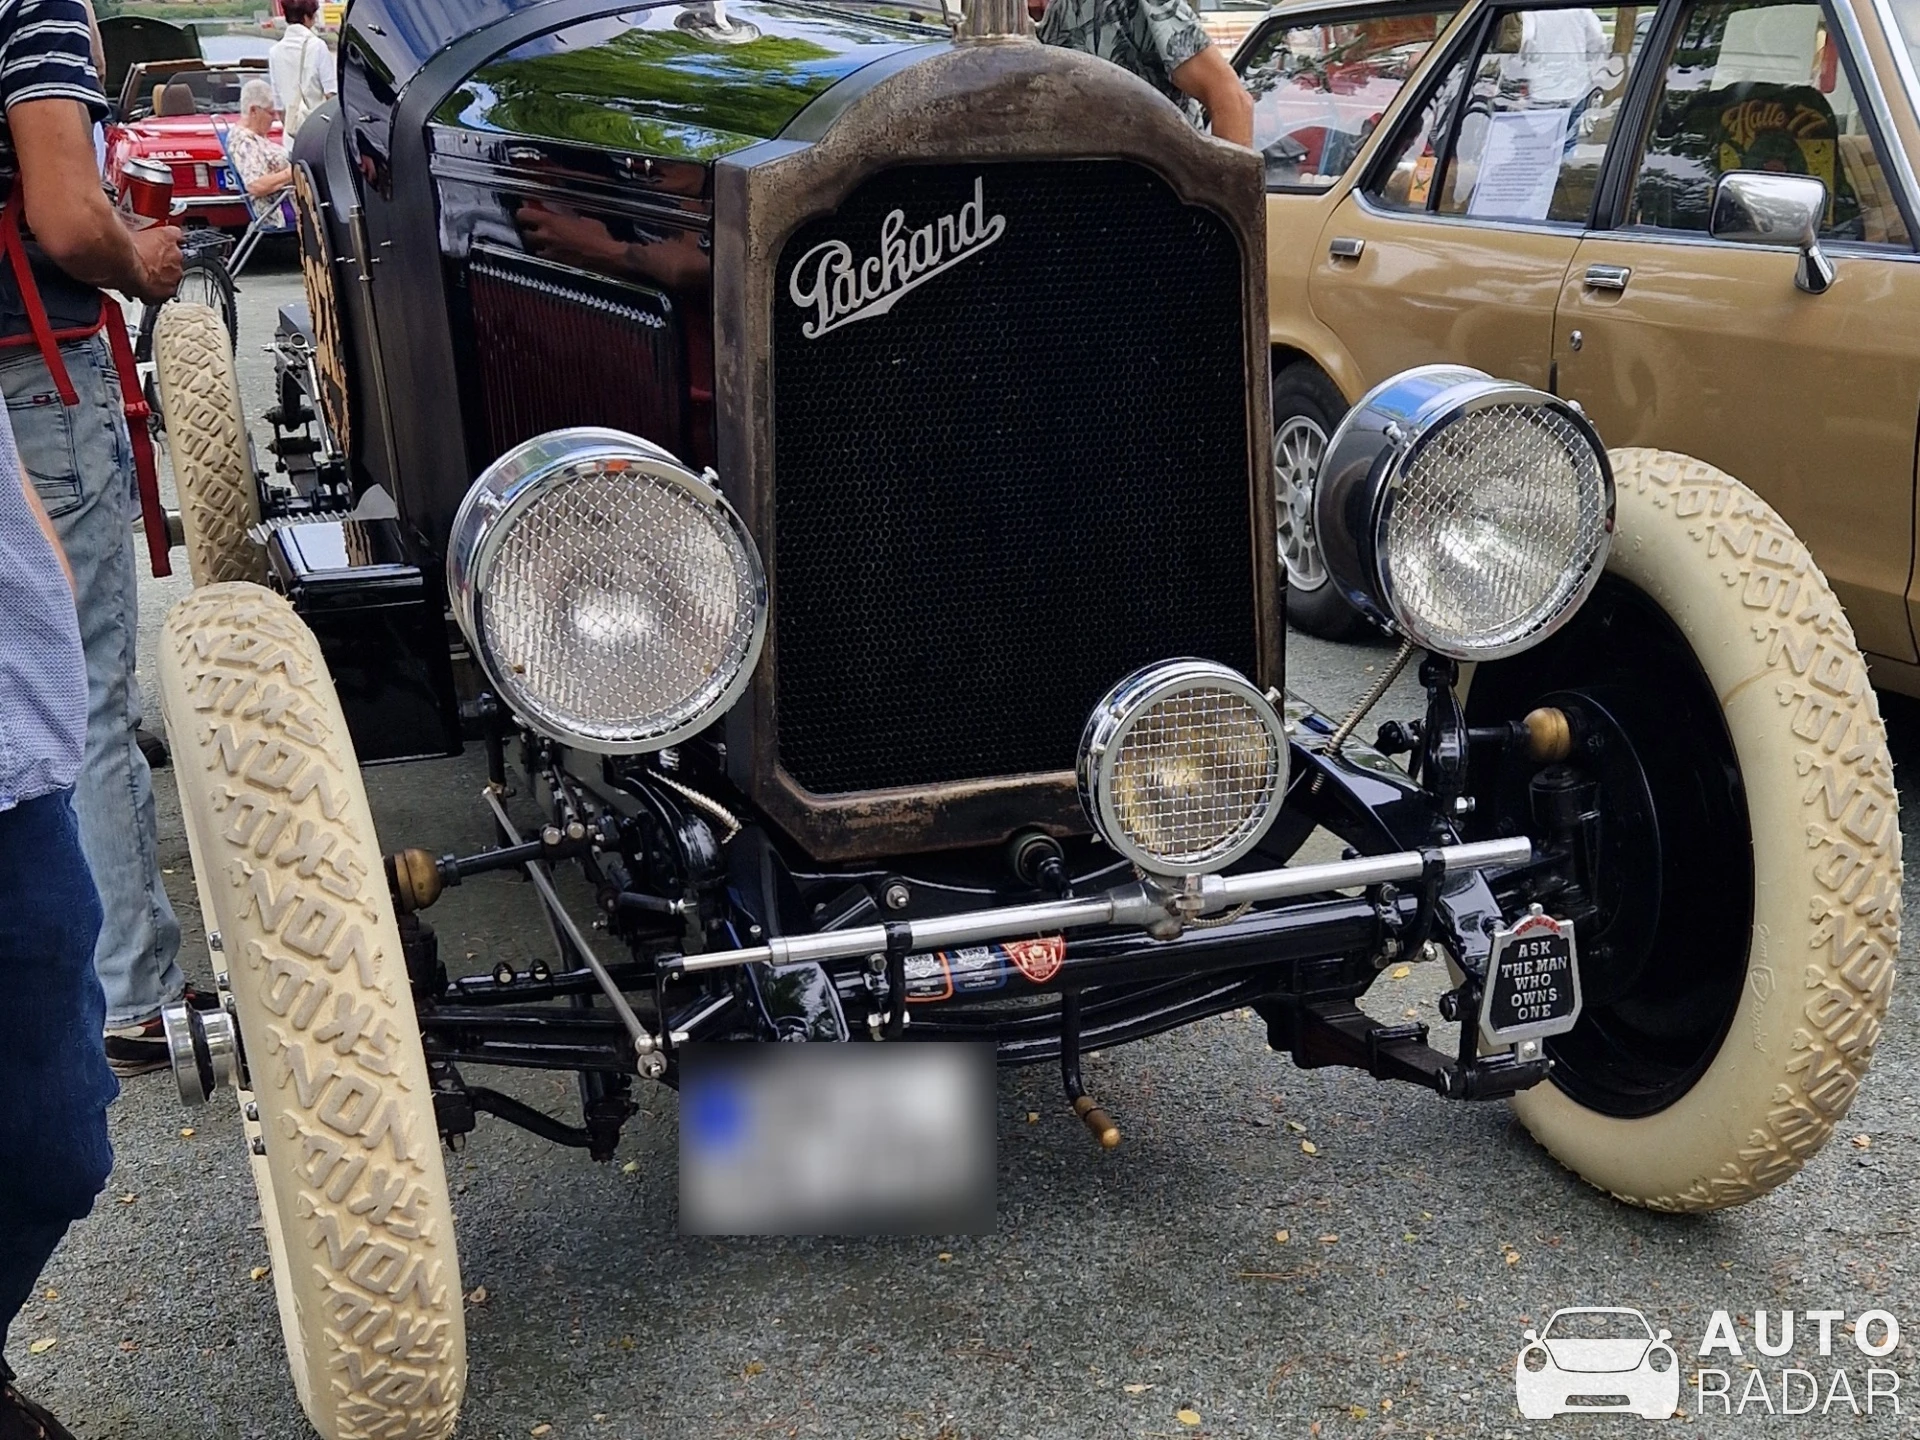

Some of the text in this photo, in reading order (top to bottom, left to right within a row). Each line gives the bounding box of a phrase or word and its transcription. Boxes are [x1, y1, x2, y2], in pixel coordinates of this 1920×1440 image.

[1721, 100, 1829, 147] Halle 77
[789, 176, 1006, 339] Packard
[207, 723, 351, 820] NON
[223, 792, 369, 901] SKID
[238, 866, 383, 990] NON
[1501, 956, 1568, 978] THE MAN
[1518, 941, 1551, 958] ASK
[260, 957, 402, 1076] SKID
[1511, 987, 1558, 1007] OWNS
[1514, 973, 1551, 990] WHO
[1518, 1004, 1552, 1020] ONE
[275, 1042, 415, 1162] NON
[306, 1212, 446, 1309] NON
